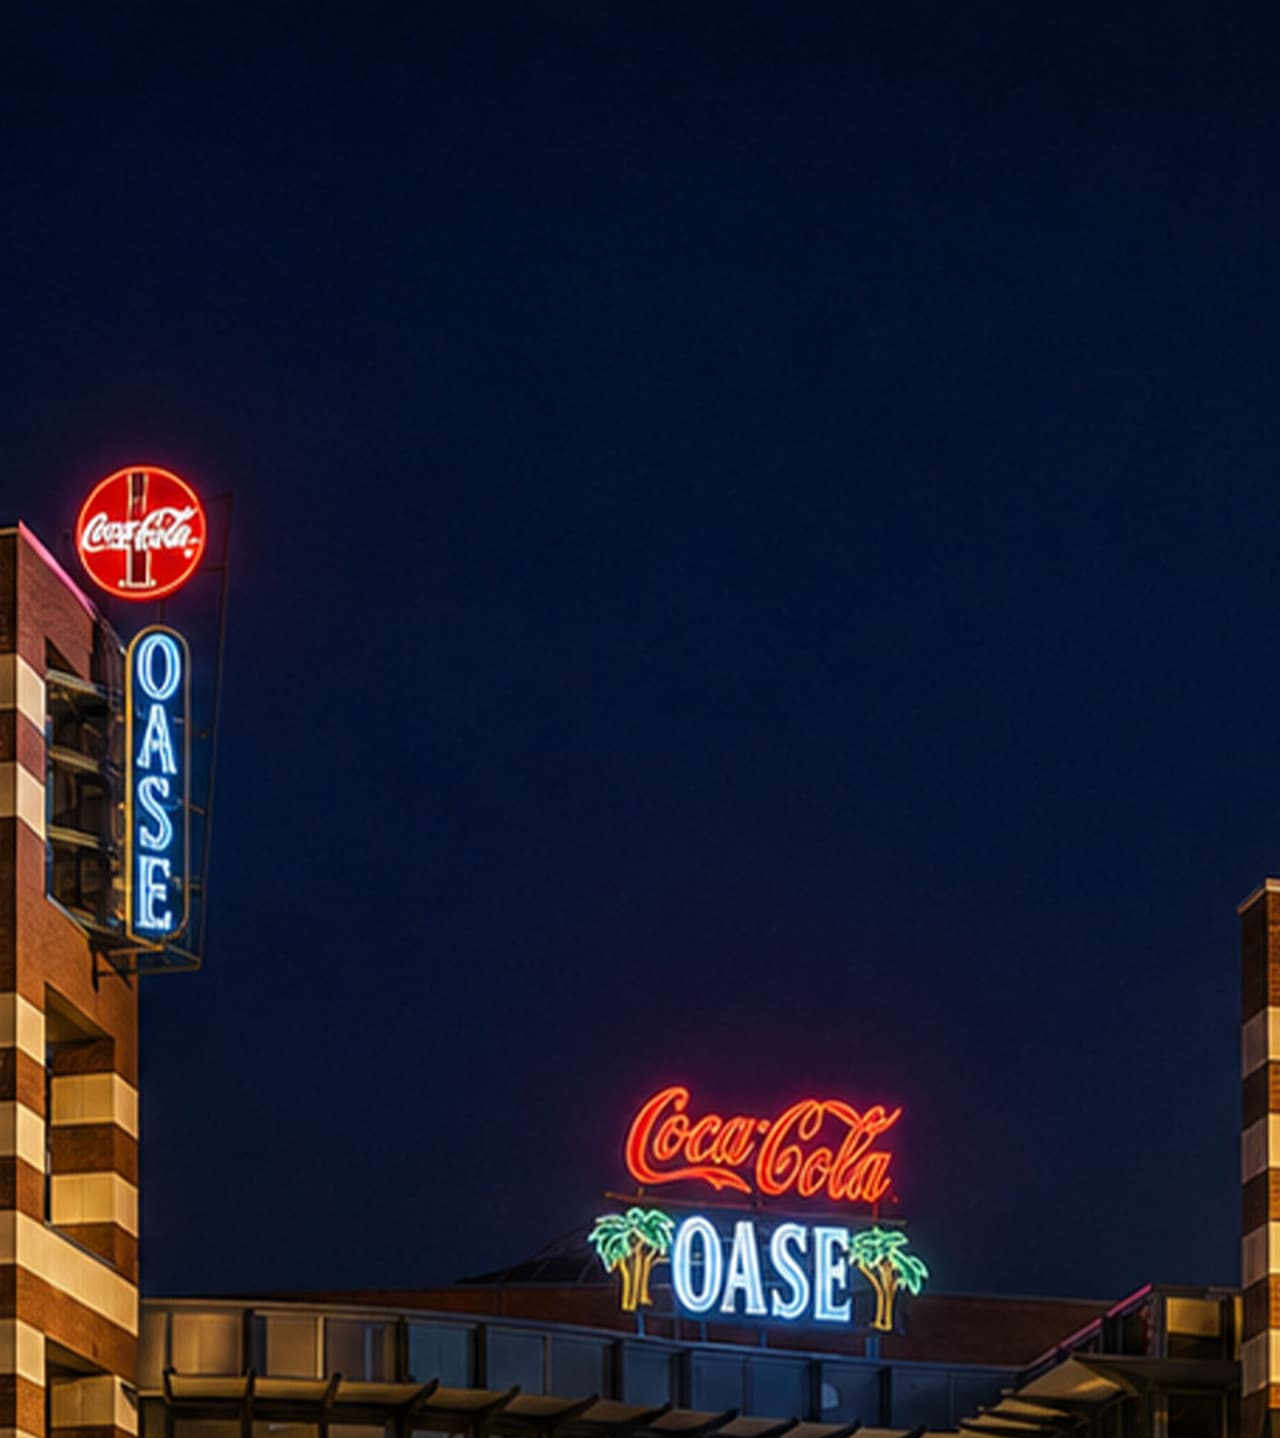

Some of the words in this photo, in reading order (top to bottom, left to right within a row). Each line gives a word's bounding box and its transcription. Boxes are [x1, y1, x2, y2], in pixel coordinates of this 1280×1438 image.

[135, 633, 181, 931] OASE
[625, 1086, 902, 1203] Coca-Cola
[673, 1216, 852, 1322] OASE
